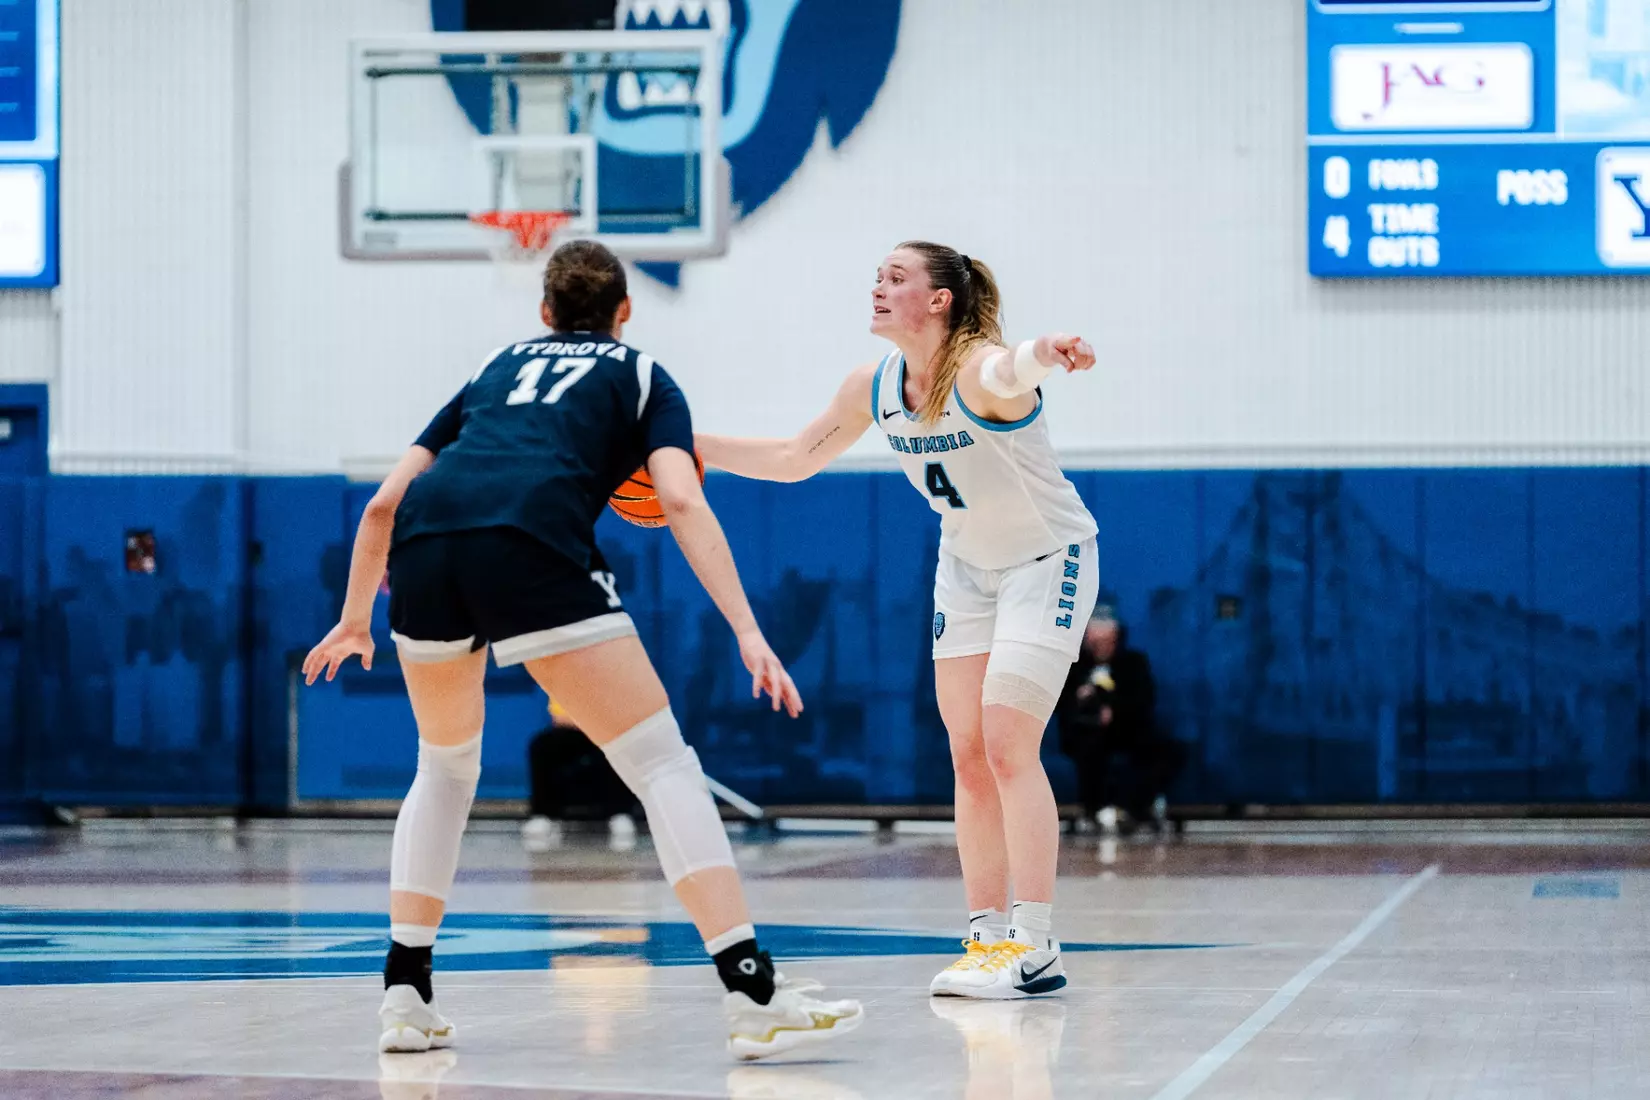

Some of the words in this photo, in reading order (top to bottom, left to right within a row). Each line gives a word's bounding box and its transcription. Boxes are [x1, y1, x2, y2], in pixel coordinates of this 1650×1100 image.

[1368, 158, 1439, 191] FOULS
[1496, 169, 1568, 206] POSS
[1322, 215, 1351, 258] 4
[1367, 203, 1439, 235] TIME
[1367, 236, 1439, 267] OUTS
[512, 341, 628, 362] VYDROVA
[505, 356, 598, 406] 17
[924, 461, 968, 510] 4
[590, 570, 622, 608] Y
[1055, 543, 1080, 629] LIONS
